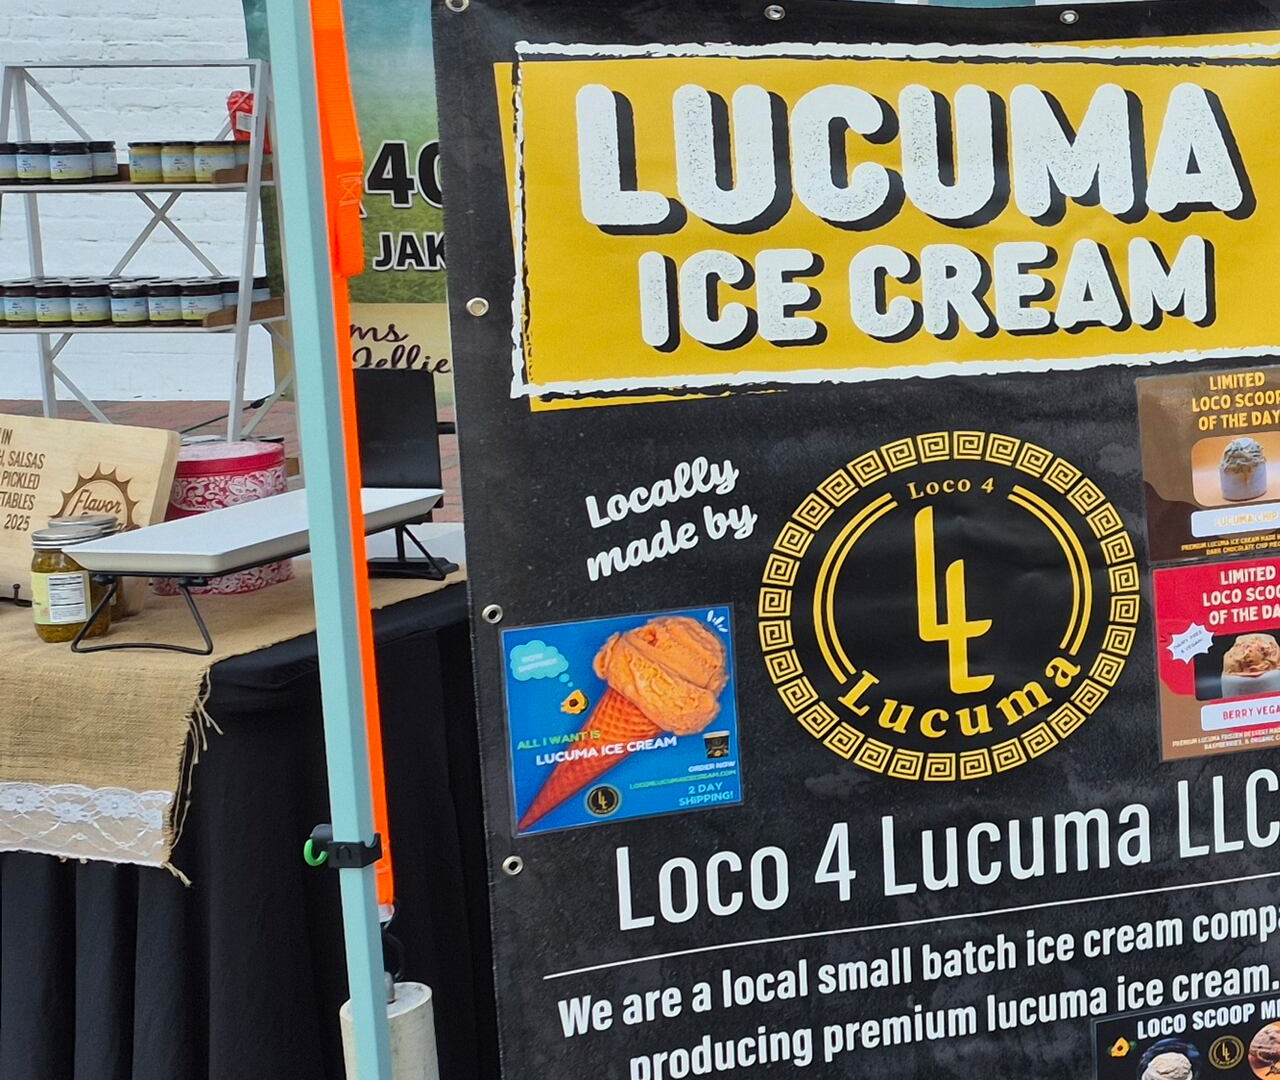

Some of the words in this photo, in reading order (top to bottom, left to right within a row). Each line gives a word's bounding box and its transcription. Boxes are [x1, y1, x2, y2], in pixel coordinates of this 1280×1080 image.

[576, 83, 1255, 235] LUCUMA
[639, 246, 824, 353] ICE
[849, 235, 1215, 342] CREAM
[1209, 372, 1265, 391] LIMITED
[1192, 394, 1231, 412] LOCO
[1198, 414, 1217, 431] OF
[1220, 411, 1249, 429] THE
[8, 450, 45, 469] SALSAS
[1, 471, 40, 490] PICKLED
[907, 477, 971, 500] Loco
[980, 477, 995, 494] 4
[69, 489, 122, 517] Flavor
[585, 456, 740, 530] Locally
[4, 514, 31, 531] 2025
[586, 524, 696, 582] made
[705, 505, 759, 554] by
[1220, 566, 1276, 585] LIMITED
[1203, 589, 1242, 607] LOCO
[1209, 608, 1228, 625] OF
[1230, 605, 1259, 623] THE
[838, 654, 1083, 738] Lucuma
[1223, 705, 1253, 721] BERRY
[517, 738, 540, 750] ALL
[549, 732, 588, 745] WANT
[591, 731, 601, 740] IS
[536, 748, 598, 766] LUCUMA
[602, 743, 624, 756] ICE
[627, 736, 677, 752] CREAM
[679, 791, 733, 806] SHIPPING!
[688, 786, 694, 795] 2
[697, 782, 723, 794] DAY
[616, 844, 790, 932] Loco
[814, 821, 858, 904] 4
[881, 795, 1152, 897] Lucuma
[1177, 767, 1280, 860] LLC
[558, 993, 613, 1038] We
[621, 987, 682, 1026] are
[691, 985, 712, 1016] a
[723, 958, 808, 1010] local
[818, 944, 911, 995] small
[921, 925, 1017, 982] batch
[1025, 917, 1074, 966] ice
[1083, 917, 1185, 960] cream
[630, 1026, 813, 1080] producing
[822, 1003, 976, 1063] premium
[987, 986, 1109, 1030] lucuma
[1116, 977, 1164, 1017] ice
[1170, 963, 1280, 1005] cream.
[1137, 1018, 1187, 1040] LOCO
[1192, 1003, 1256, 1030] SCOOP
